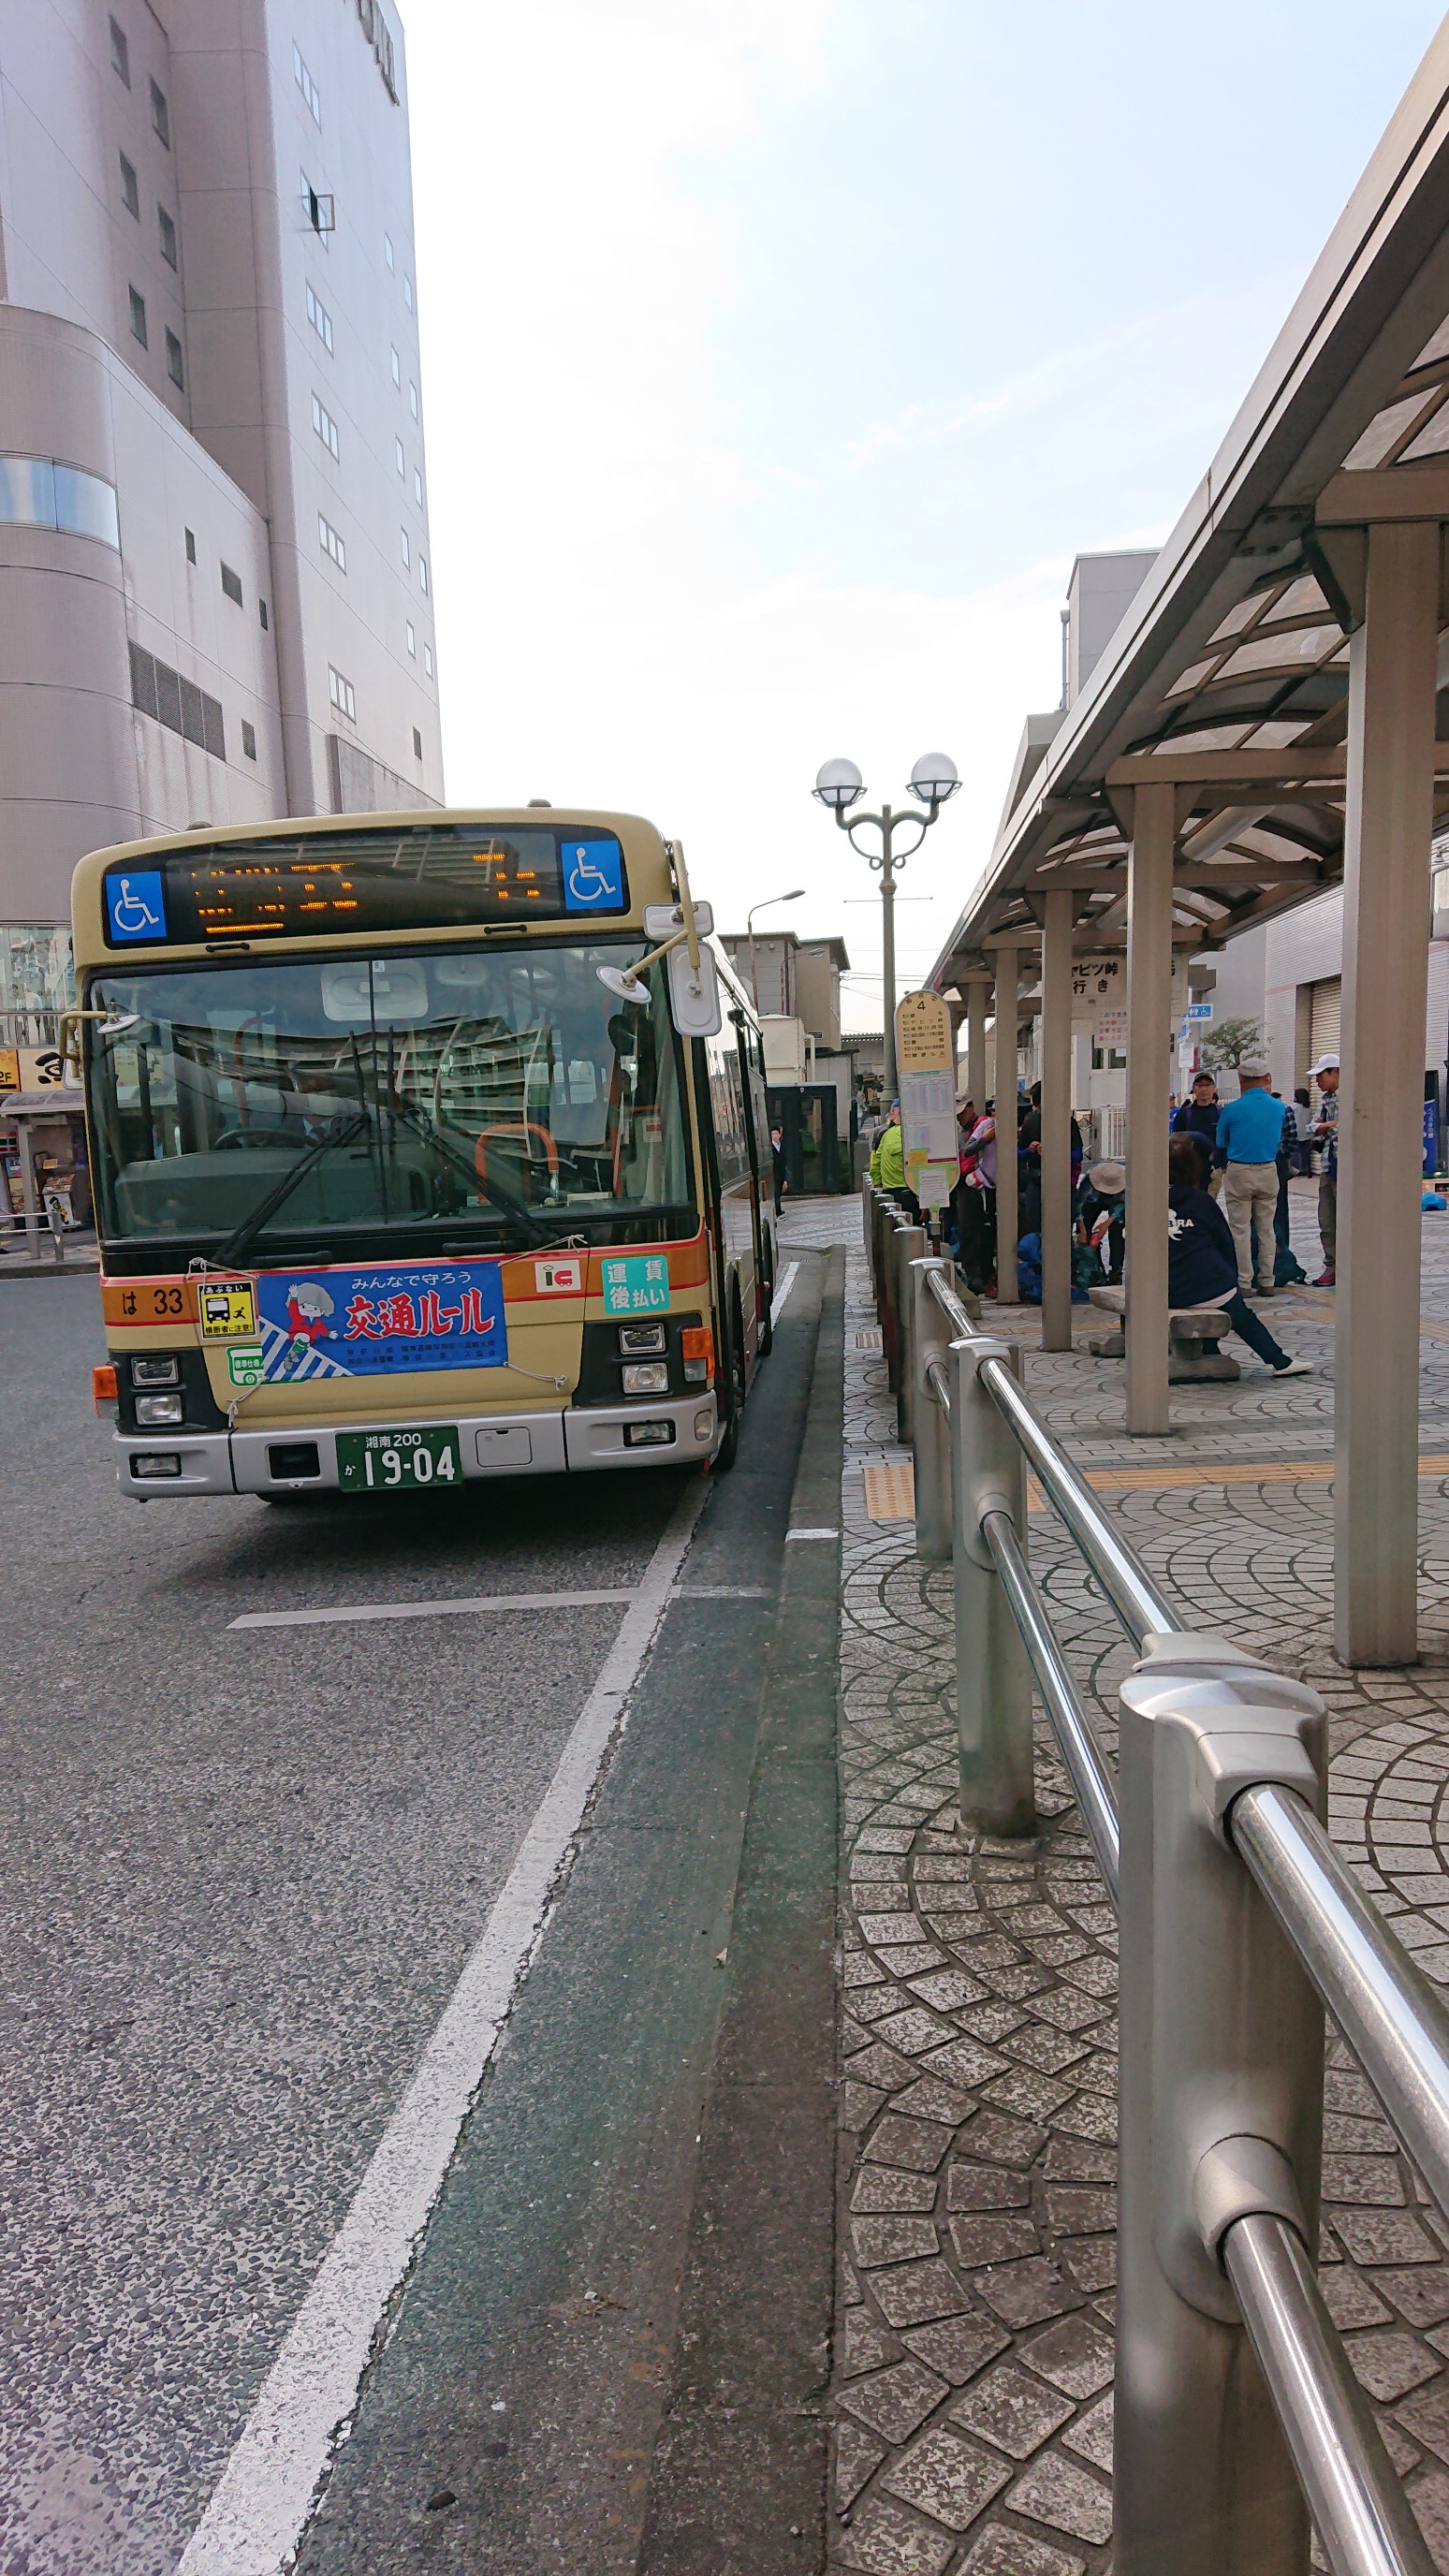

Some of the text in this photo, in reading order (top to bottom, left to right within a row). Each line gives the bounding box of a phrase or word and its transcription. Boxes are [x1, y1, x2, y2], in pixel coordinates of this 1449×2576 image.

[1073, 979, 1109, 994] 行き
[916, 1001, 927, 1011] 4
[205, 1285, 243, 1295] あぶない
[351, 1270, 472, 1290] みんなで守ろう
[123, 1288, 183, 1315] は 33
[609, 1286, 666, 1310] 後払い
[344, 1286, 496, 1340] 交通ルール
[365, 1432, 422, 1449] 湘南 200
[344, 1445, 456, 1486] か 19-04
